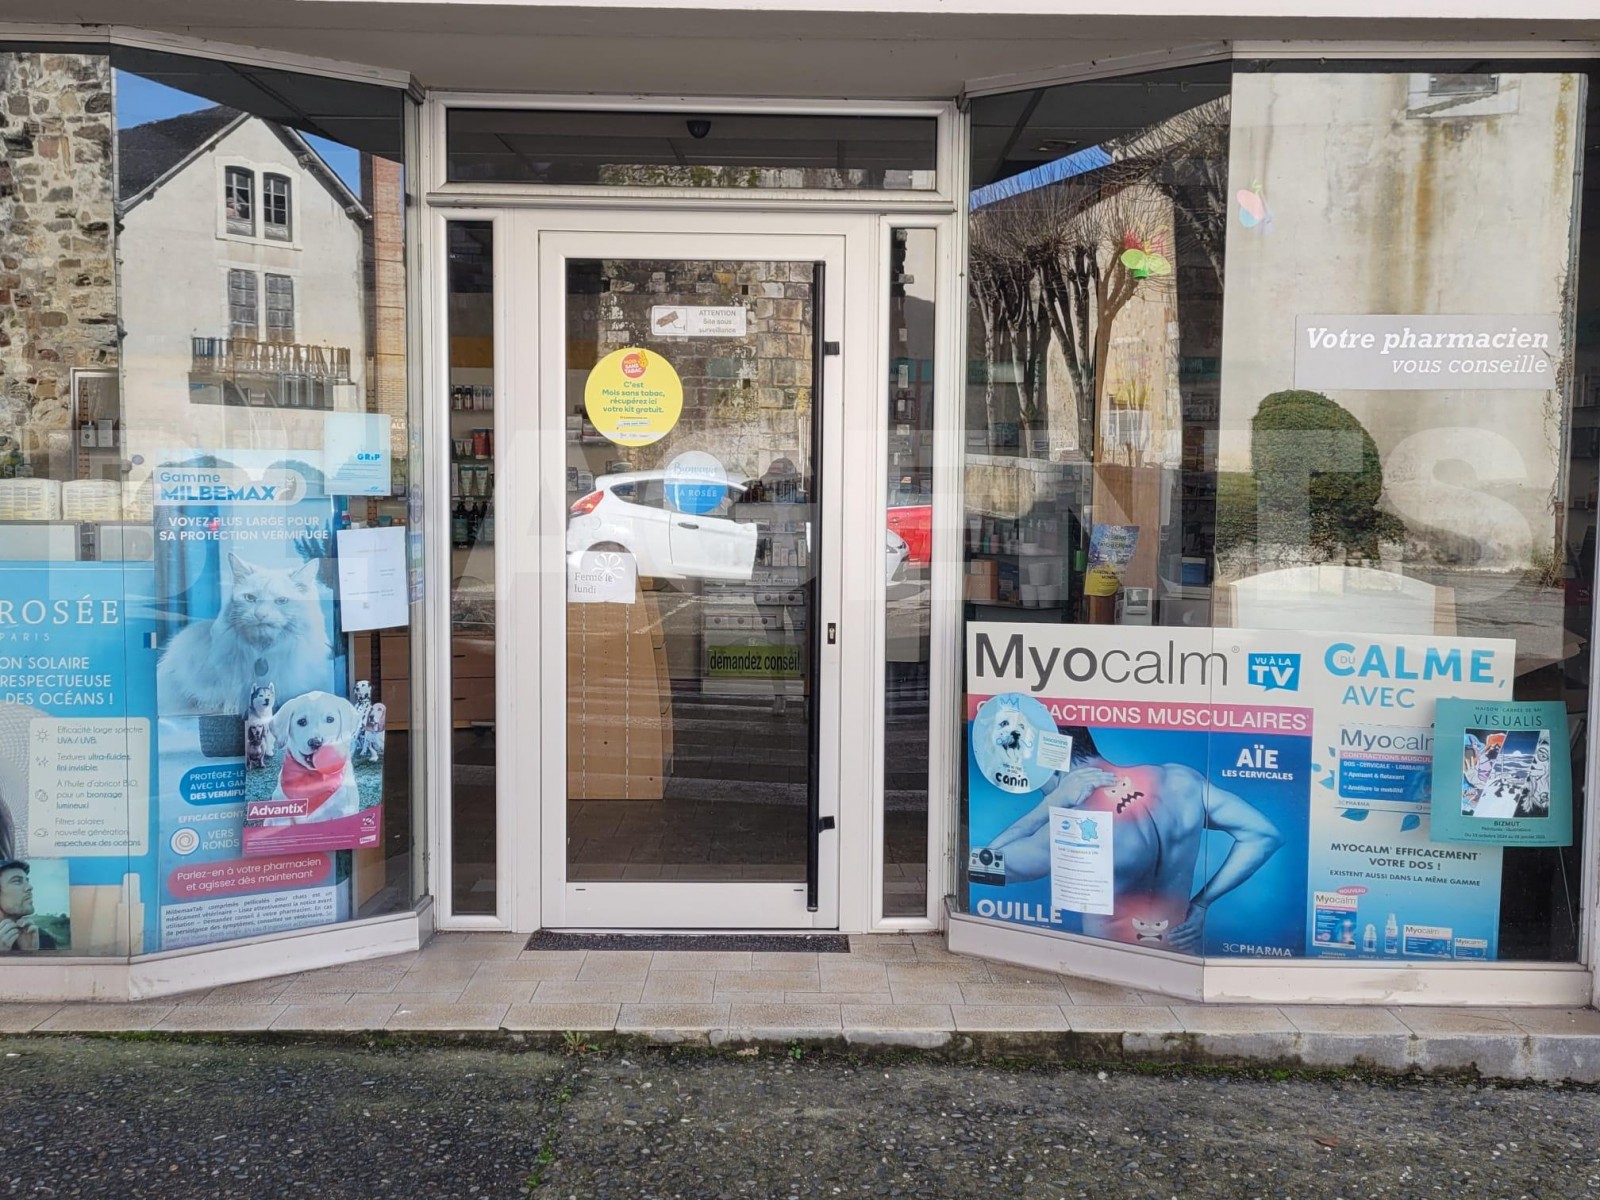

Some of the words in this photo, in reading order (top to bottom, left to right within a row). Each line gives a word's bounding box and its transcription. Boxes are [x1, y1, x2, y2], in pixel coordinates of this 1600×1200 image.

[699, 309, 736, 317] ATTENTION
[1306, 327, 1375, 350] Votre
[1380, 327, 1549, 354] pharmacien
[1392, 358, 1441, 373] vous
[1448, 355, 1548, 373] conseille
[623, 381, 644, 389] C'est
[602, 389, 620, 397] Mois
[641, 389, 665, 398] tabac,
[610, 396, 647, 407] récupérez
[648, 397, 657, 405] ici
[603, 405, 623, 413] votre
[624, 405, 635, 413] kit
[636, 405, 664, 414] gratuit.
[160, 472, 220, 483] Gamme
[160, 485, 276, 501] MILBEMAX
[688, 486, 717, 497] ROSÉE
[168, 517, 209, 527] VOYEZ
[213, 517, 243, 527] PLUS
[246, 517, 286, 527] LARGE
[287, 517, 319, 527] POUR
[159, 530, 176, 541] SA
[180, 530, 260, 541] PROTECTION
[262, 529, 329, 541] VERMIFUGE
[574, 572, 603, 582] Fermé
[573, 584, 597, 595] lundi
[0, 594, 120, 625] ROSÉE
[0, 632, 51, 641] PARIS
[28, 656, 90, 670] SOLAIRE
[710, 650, 762, 670] demandez
[764, 650, 800, 671] conseil
[1254, 656, 1268, 667] VU
[1268, 655, 1277, 667] À
[1278, 658, 1292, 668] LA
[1323, 642, 1506, 689] CALME,
[1339, 655, 1356, 665] DU
[0, 674, 112, 688] RESPECTUEUSE
[1251, 665, 1296, 688] TV
[6, 692, 34, 706] DES
[39, 690, 105, 706] OCÉANS
[109, 692, 114, 705] !
[1341, 685, 1416, 709] AVEC
[1147, 708, 1308, 731] MUSCULAIRES
[1473, 714, 1543, 727] VISUALIS
[57, 726, 91, 734] Efficacité
[92, 726, 113, 735] large
[114, 727, 143, 735] spectre
[57, 736, 73, 744] UVA
[57, 753, 86, 761] Textures
[1236, 744, 1279, 769] AÏE
[1343, 752, 1400, 761] CONTRACTIONS
[56, 764, 68, 772] fini
[1221, 769, 1238, 778] LES
[1239, 770, 1294, 781] CERVICALES
[86, 780, 121, 788] d'abricot
[190, 782, 213, 791] AVEC
[215, 781, 225, 789] LA
[227, 779, 246, 788] GAM
[56, 791, 74, 800] pour
[86, 791, 123, 800] bronzage
[190, 792, 208, 801] DES
[209, 789, 245, 799] VERMIFU
[249, 803, 304, 816] Advantix
[55, 817, 75, 825] Filtres
[77, 817, 105, 825] solaires
[178, 813, 219, 823] EFFICACE
[220, 809, 245, 819] CONT
[55, 828, 86, 837] nouvelle
[207, 828, 234, 839] VERS
[54, 840, 96, 848] respectueux
[98, 839, 111, 847] des
[202, 838, 240, 850] RONDS
[1330, 843, 1390, 855] MYOCALM
[1395, 847, 1478, 861] EFFICACEMENT
[177, 868, 225, 880] Parlez-en
[227, 866, 235, 875] à
[236, 864, 261, 874] votre
[263, 857, 322, 873] pharmacien
[1369, 857, 1405, 868] VOTRE
[1408, 860, 1433, 870] DOS
[1436, 862, 1441, 871] !
[186, 882, 197, 893] et
[198, 877, 236, 893] agissez
[238, 872, 256, 886] dès
[258, 869, 314, 884] maintenant
[1329, 869, 1363, 878] EXISTENT
[1365, 872, 1388, 880] AUSSI
[1389, 873, 1411, 882] DANS
[1413, 875, 1423, 883] LA
[1424, 875, 1448, 884] MÊME
[1449, 879, 1481, 887] GAMME
[1315, 894, 1357, 905] Myocalm
[165, 912, 201, 923] médicament
[202, 908, 232, 919] vétérinaire
[238, 906, 253, 914] Lisez
[253, 902, 292, 912] attentivement
[299, 898, 316, 907] notice
[977, 898, 1063, 924] OUILLE
[165, 920, 195, 930] utilisation
[234, 913, 254, 921] conseil
[262, 909, 277, 917] votre
[175, 926, 209, 937] persistance
[1405, 926, 1440, 936] Myocalm
[1222, 942, 1293, 958] 3CPHARMA
